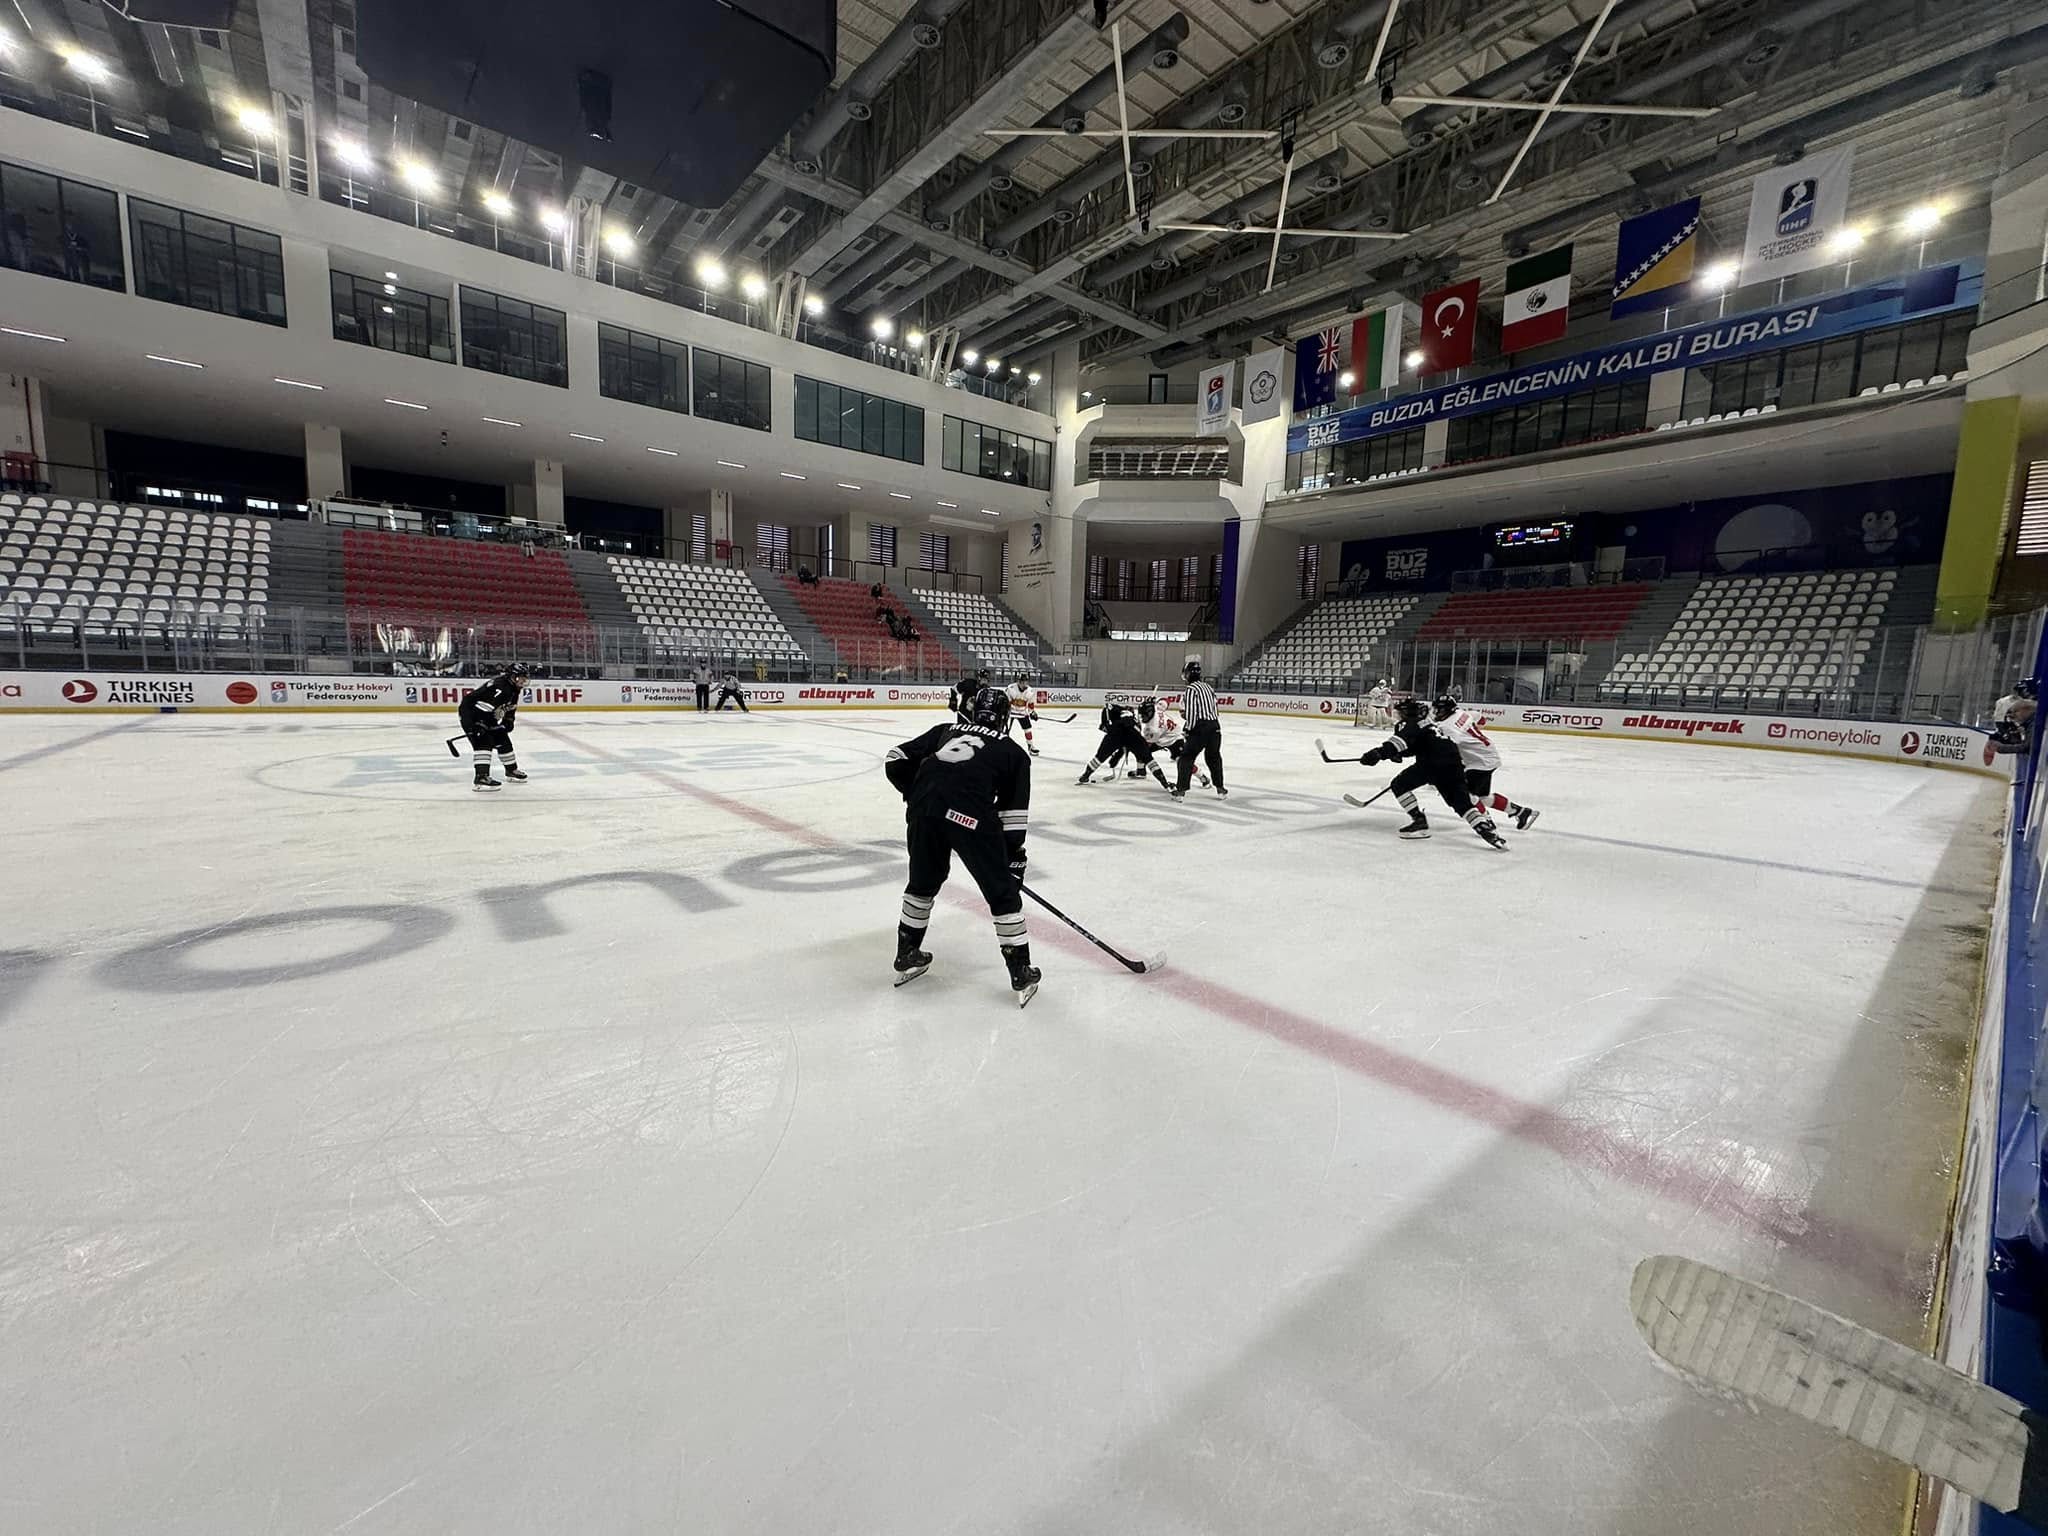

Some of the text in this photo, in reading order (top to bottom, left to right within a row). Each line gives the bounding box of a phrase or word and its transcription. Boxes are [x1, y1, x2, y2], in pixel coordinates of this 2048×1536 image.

[1781, 217, 1808, 233] IIHF
[1779, 234, 1824, 251] HOCKEY
[1371, 306, 1819, 427] BUZDA EĞLENCENİN KALBİ BURASI
[1308, 421, 1340, 439] BUZ
[1386, 553, 1427, 570] BUZ
[108, 680, 193, 692] TURKISH
[288, 682, 393, 692] Türkiye Buz Hokeyi
[633, 686, 660, 694] Türkiye
[107, 692, 194, 703] AIRLINES
[306, 692, 378, 702] Federasyonu
[421, 687, 476, 703] IIHF
[536, 688, 583, 703] IIHF
[644, 694, 691, 702] Federasyonu
[799, 688, 875, 703] albayrak
[1047, 692, 1082, 703] Kelebek
[1259, 699, 1308, 711] moneytolia
[1335, 701, 1369, 709] TURKSH
[949, 723, 1008, 740] MURRAY
[1622, 715, 1745, 736] albayrak
[1790, 728, 1881, 746] moneytolia
[1926, 733, 1968, 748] TURKISH
[935, 734, 985, 763] 6
[1922, 746, 1966, 760] AIRLINES
